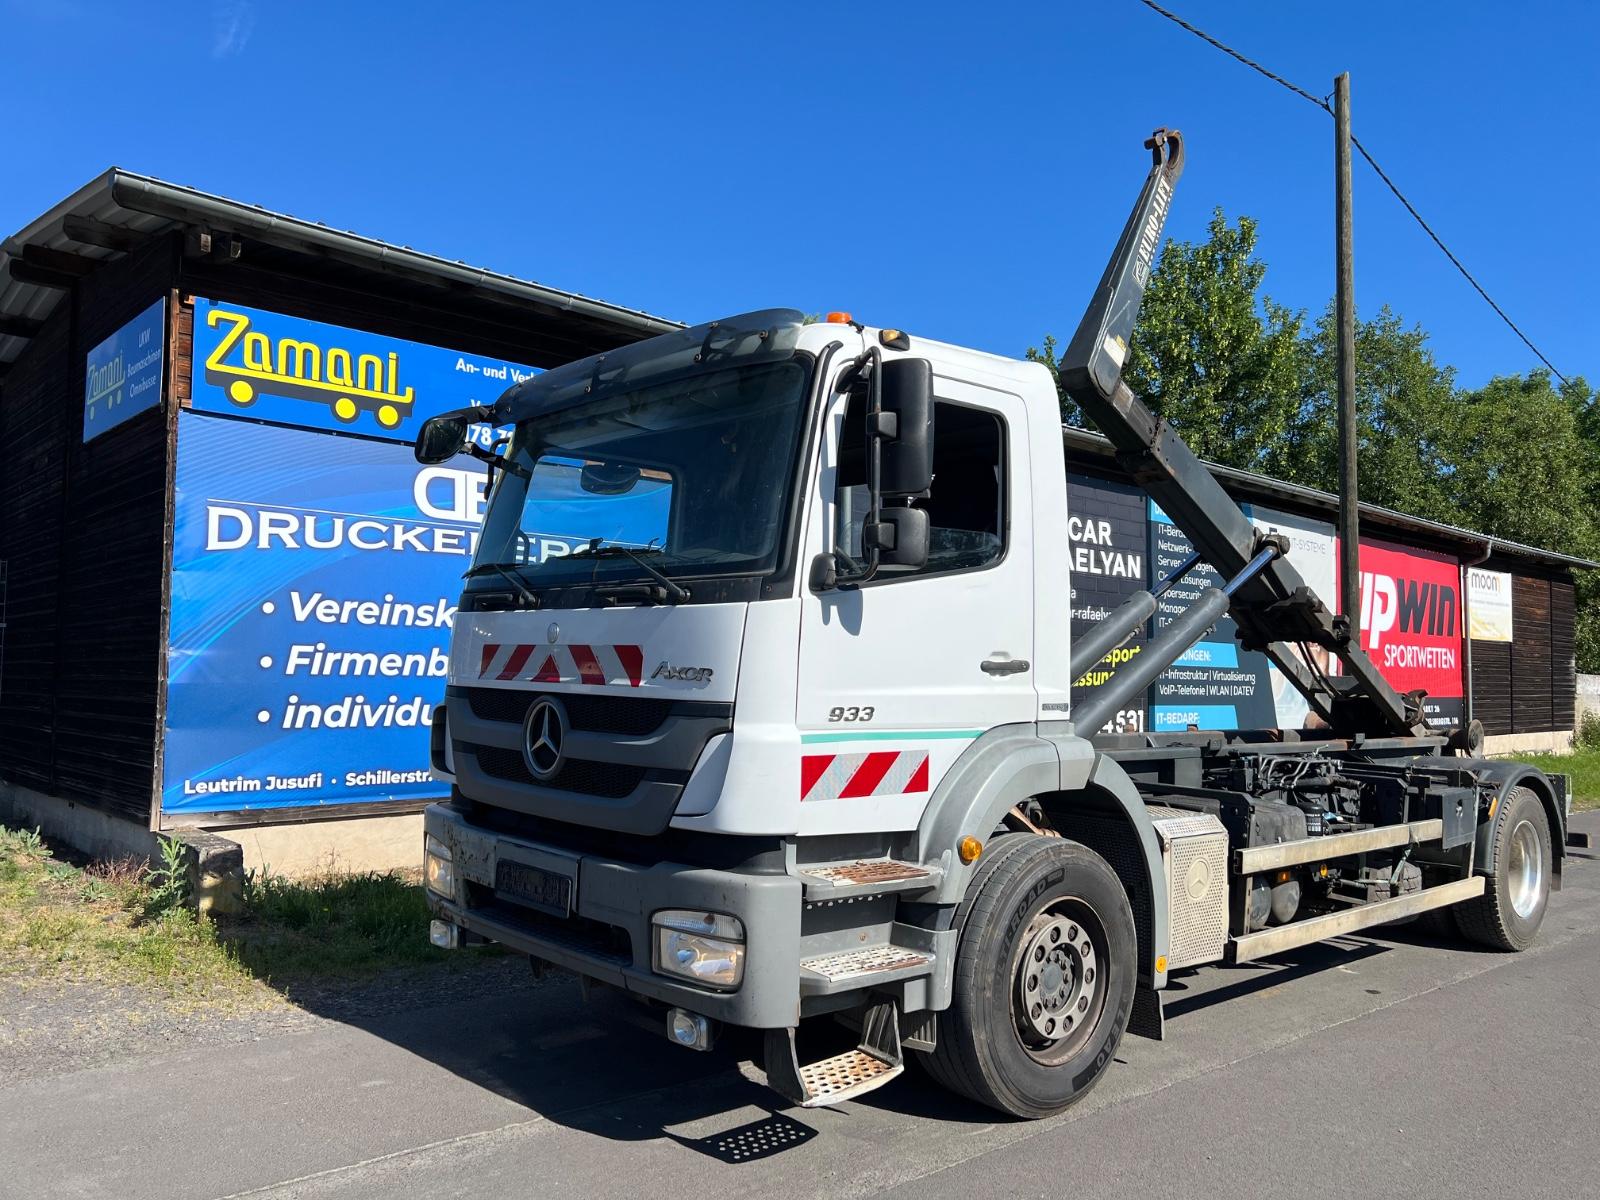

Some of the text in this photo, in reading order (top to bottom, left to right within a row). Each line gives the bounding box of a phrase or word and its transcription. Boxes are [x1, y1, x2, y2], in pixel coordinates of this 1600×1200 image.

[205, 310, 415, 404] Zamani
[87, 348, 126, 405] Zamani
[456, 358, 480, 374] An-
[483, 366, 506, 380] und
[1384, 643, 1456, 670] SPORTWETTEN
[1212, 670, 1256, 685] Virtualisierung
[1209, 686, 1230, 696] WLAN
[1233, 686, 1255, 696] DATEV
[828, 706, 875, 722] 933
[184, 770, 433, 795] Leutrim Jusufi Schillerstr.
